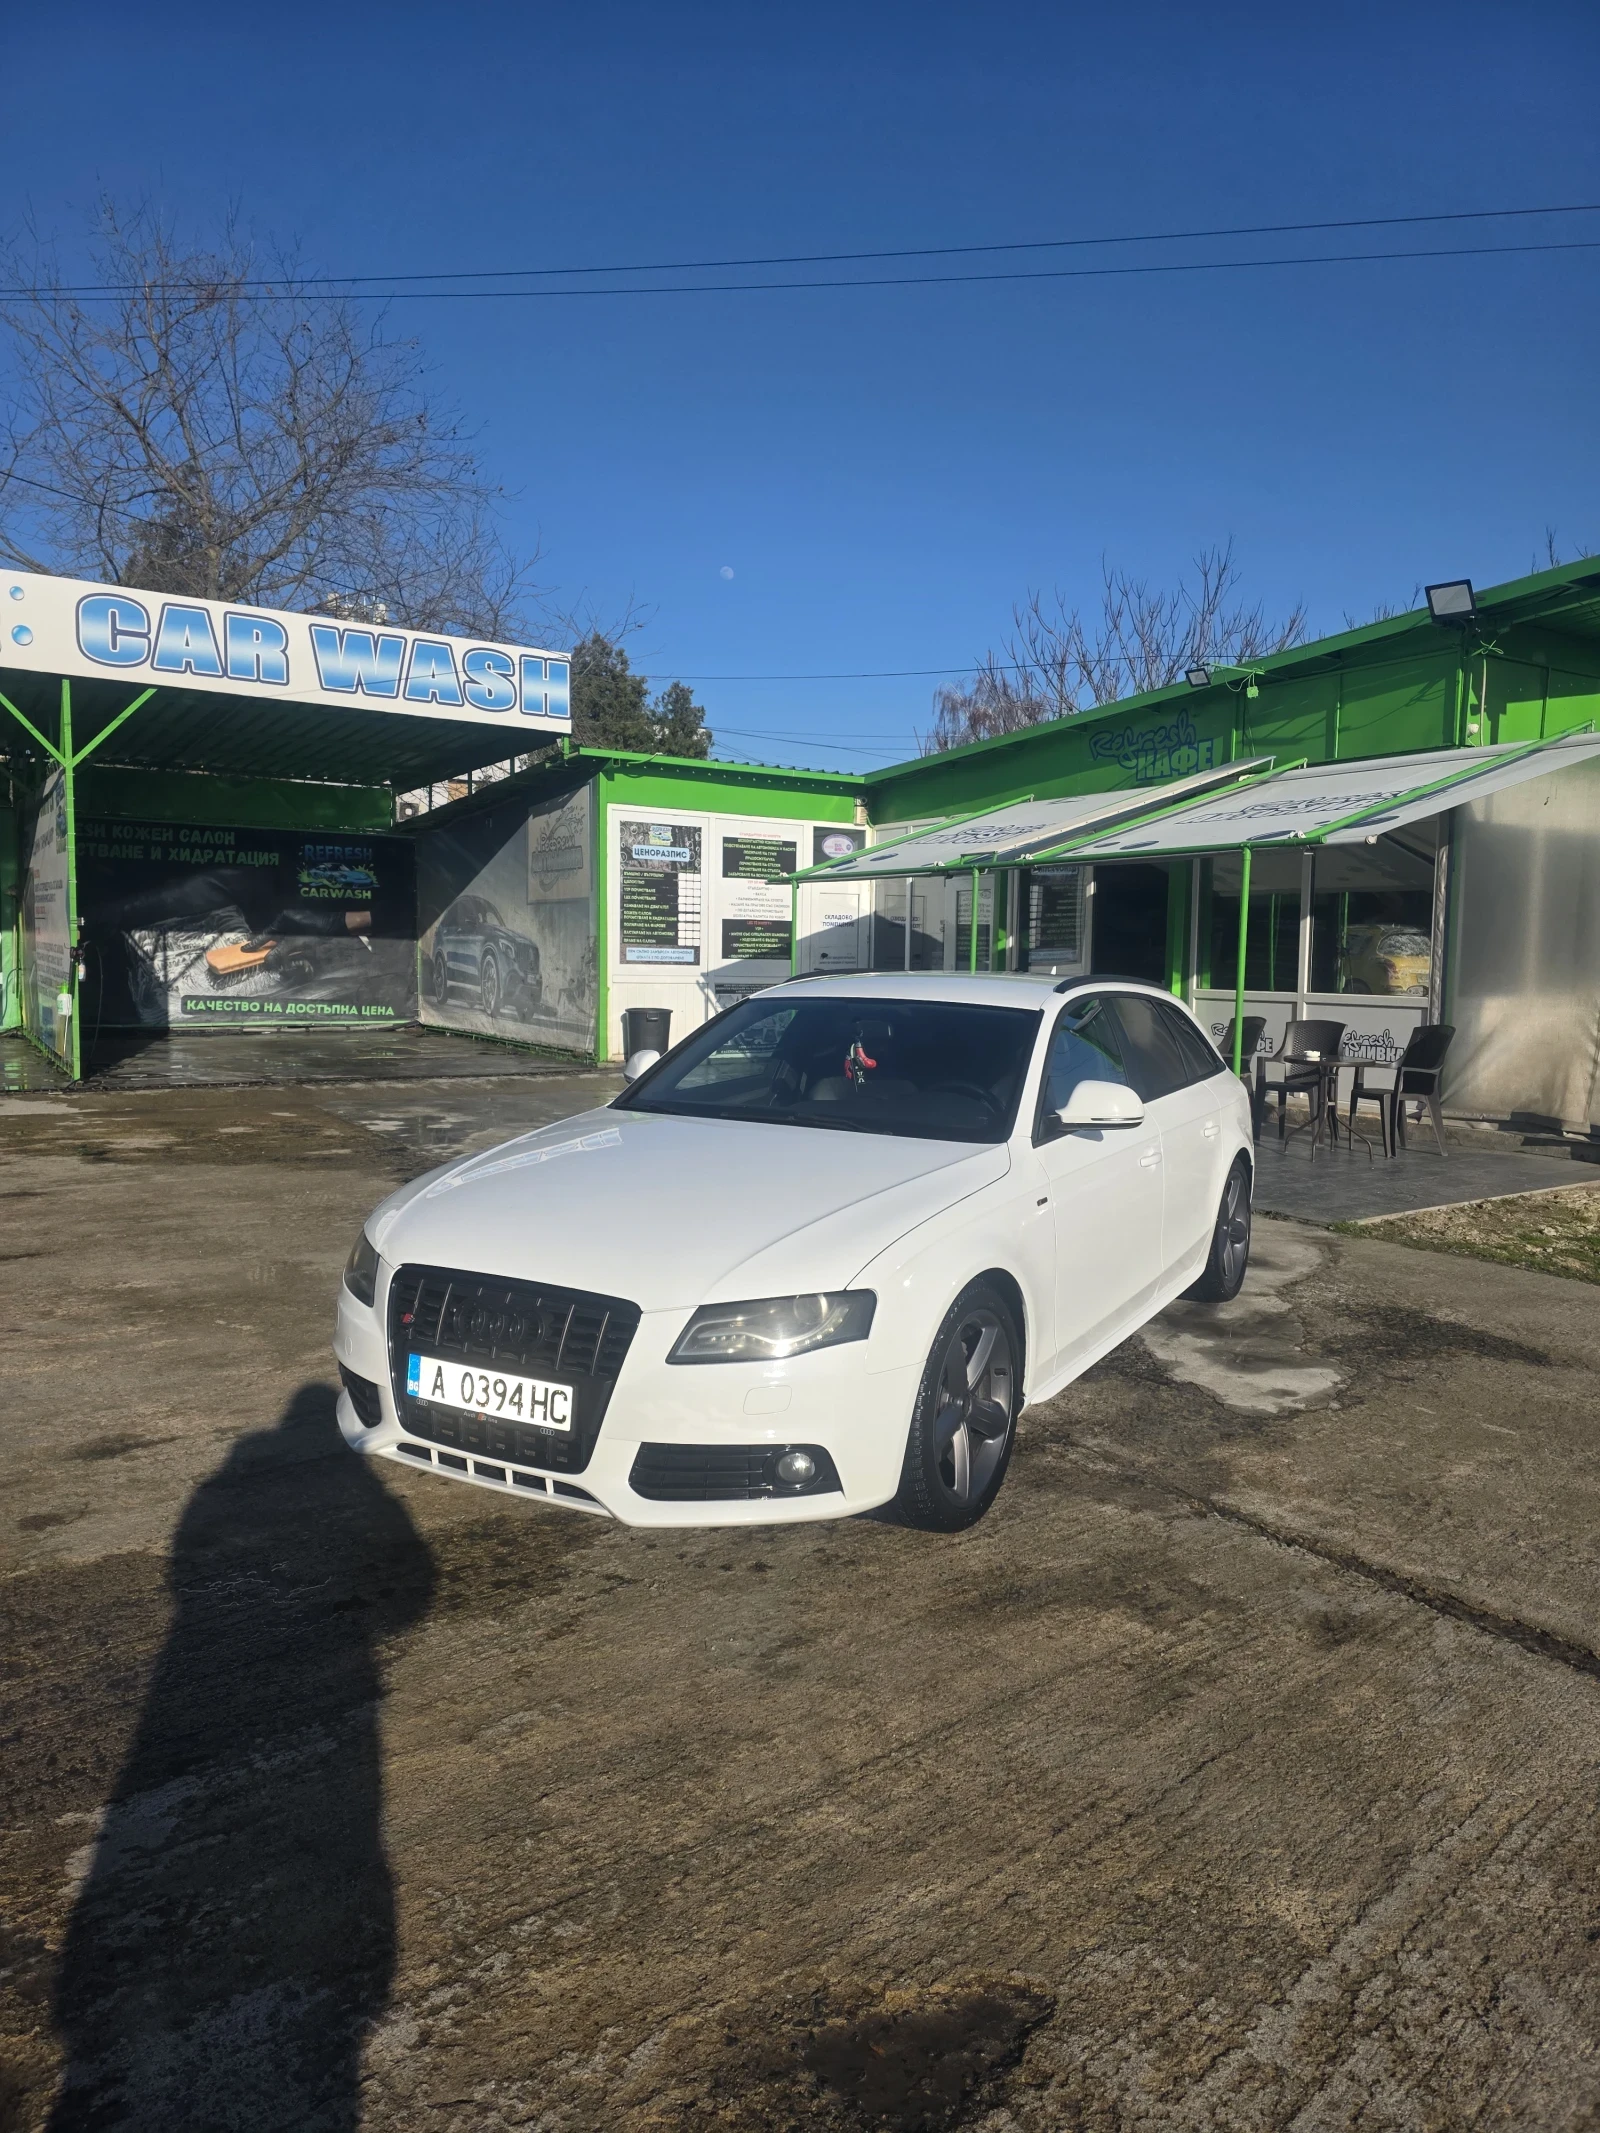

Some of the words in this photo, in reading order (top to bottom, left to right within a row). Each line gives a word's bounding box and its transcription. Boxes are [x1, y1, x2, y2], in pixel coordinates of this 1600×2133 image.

[76, 593, 289, 686] CAR
[309, 623, 571, 719] WASH
[1089, 708, 1196, 769] Refresh
[1136, 738, 1214, 781] КАФЕ
[112, 825, 174, 842] КОЖЕН
[180, 830, 235, 845] САЛОН
[150, 846, 162, 860] И
[168, 848, 279, 867] ХИДРАТАЦИЯ
[304, 844, 372, 861] REFRESH
[634, 848, 687, 858] ЦЕНОРАЗПИС
[300, 887, 372, 900] CARWASH
[186, 1000, 260, 1012] КАЧЕСТВО
[264, 1001, 282, 1013] НА
[286, 1002, 358, 1015] ДОСТЪПНА
[362, 1005, 394, 1016] ЦЕНА
[1343, 1029, 1394, 1052] efresh
[408, 1380, 419, 1392] BG
